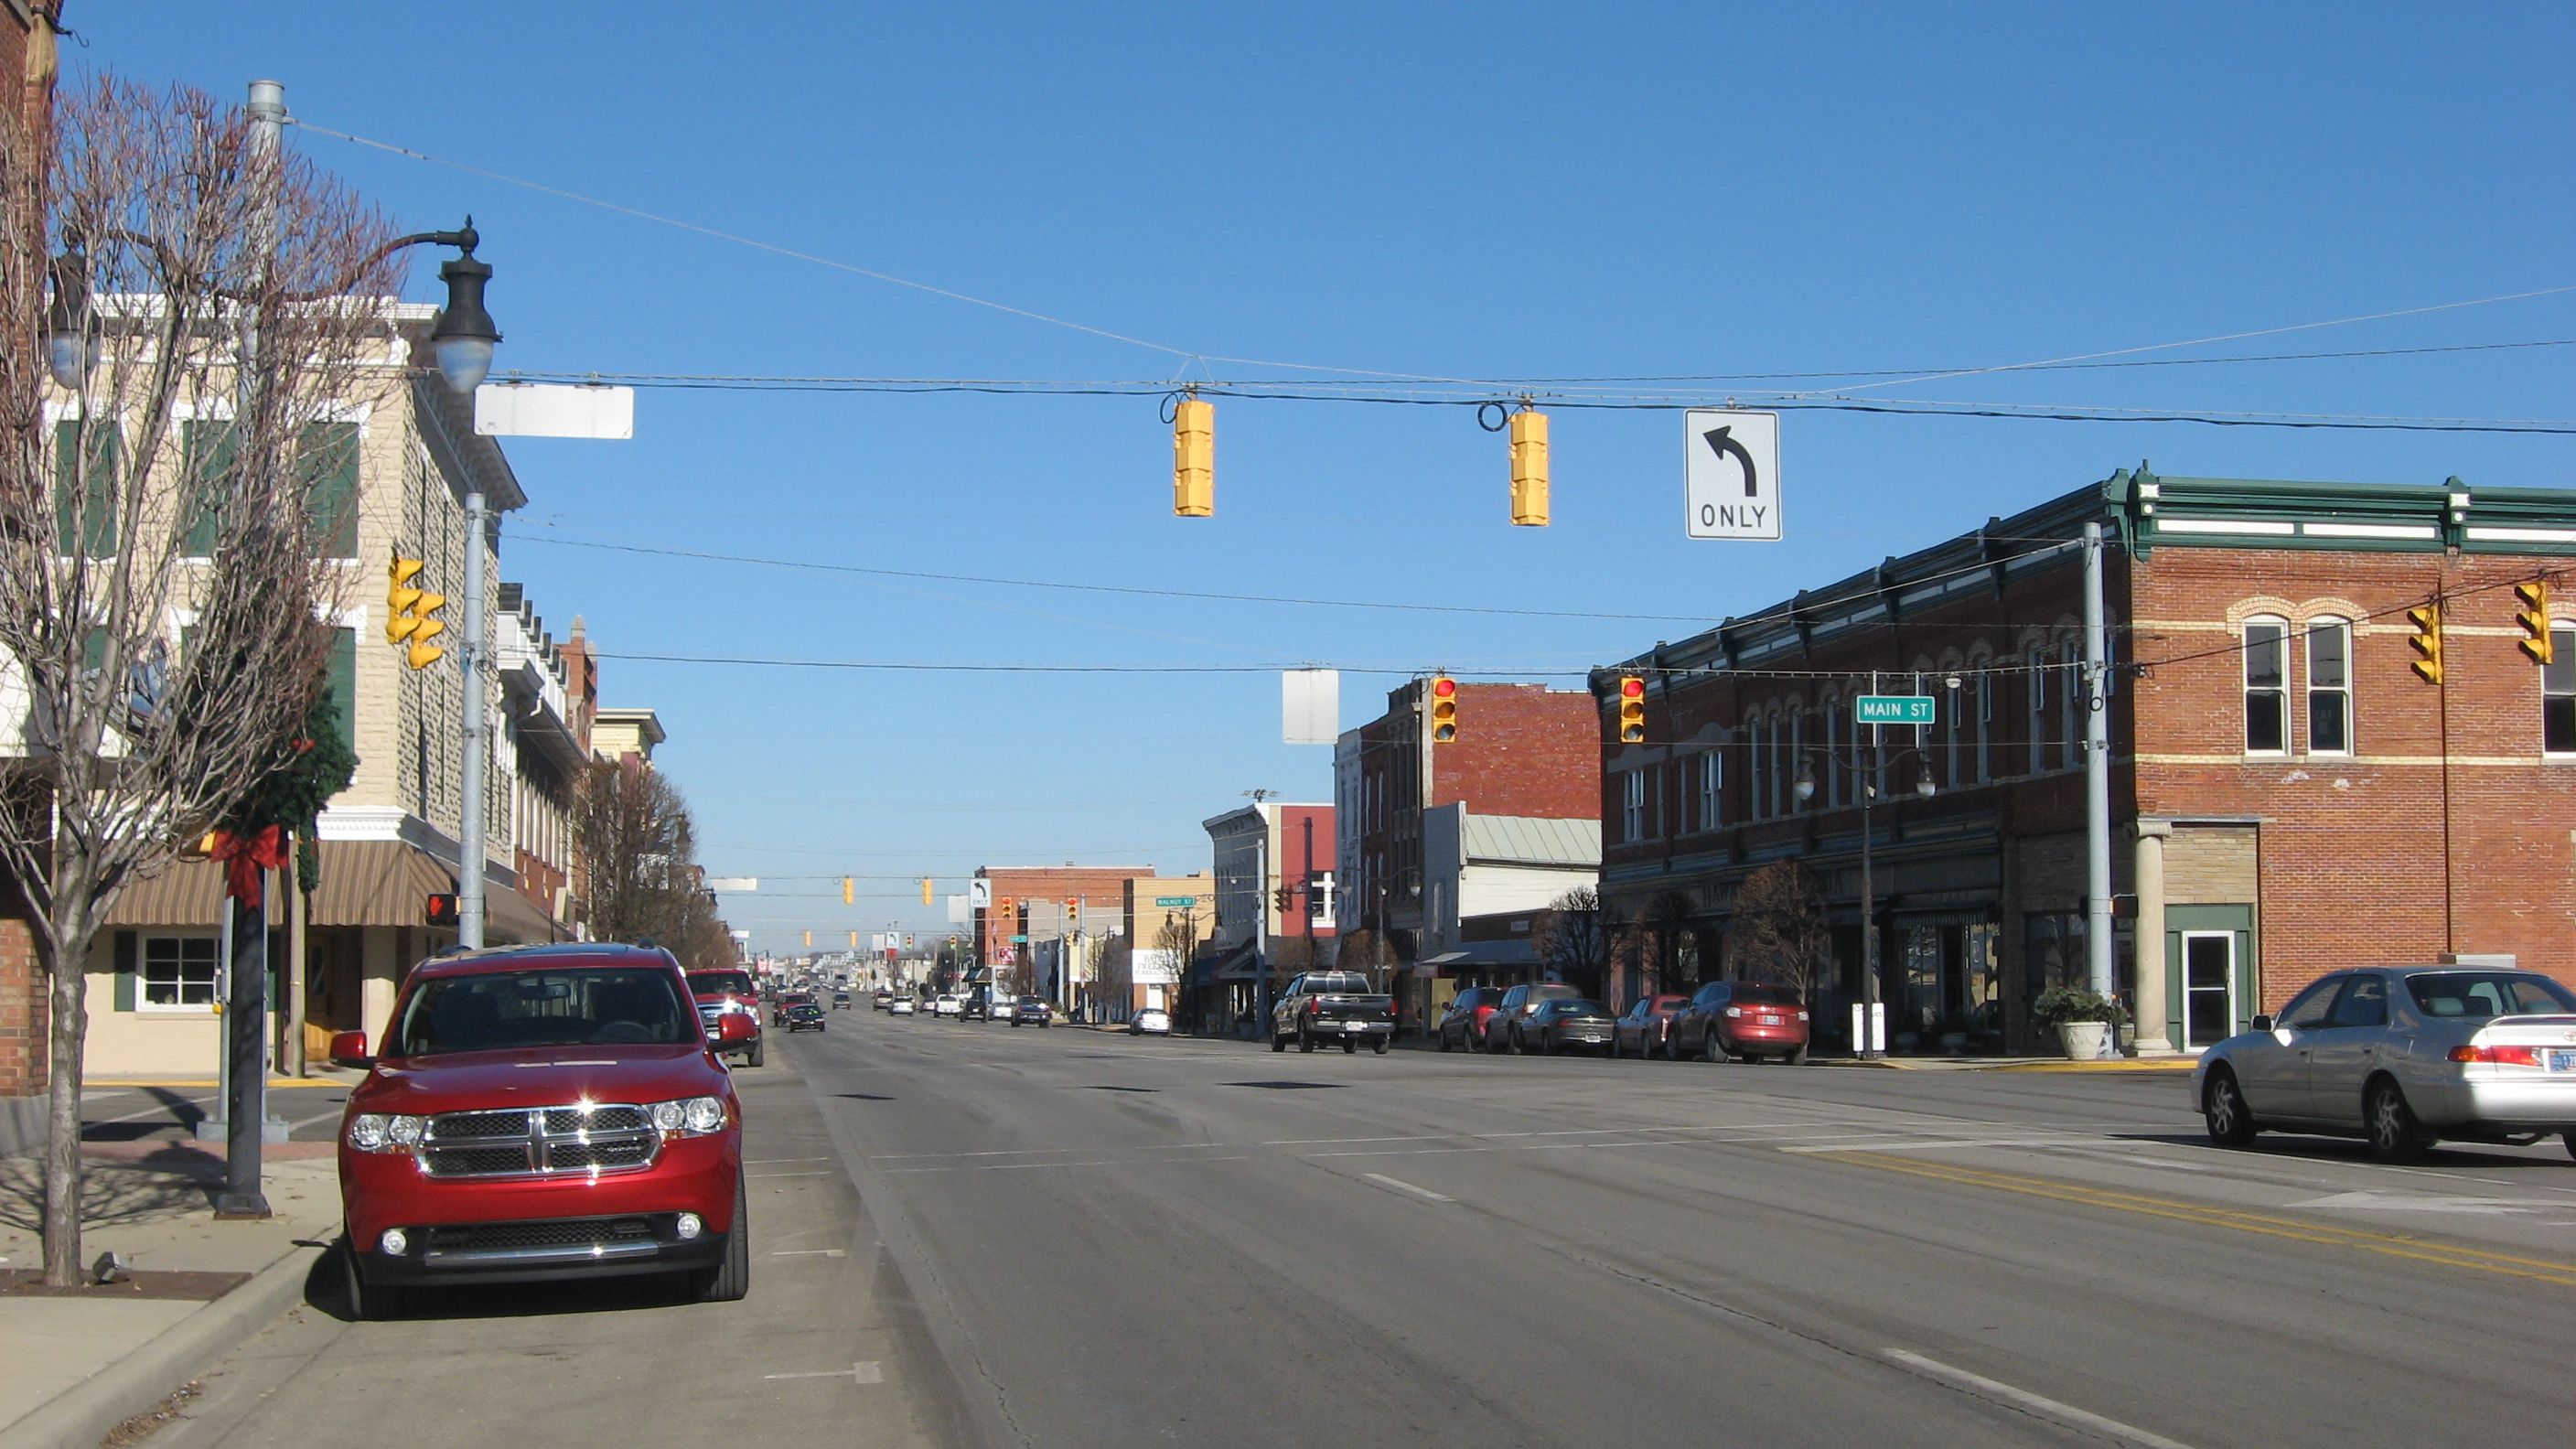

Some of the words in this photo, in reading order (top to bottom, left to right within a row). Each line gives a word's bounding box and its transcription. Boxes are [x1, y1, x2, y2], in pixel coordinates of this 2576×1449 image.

[1701, 503, 1766, 528] ONLY
[1863, 703, 1902, 716] MAIN
[1910, 703, 1928, 717] ST
